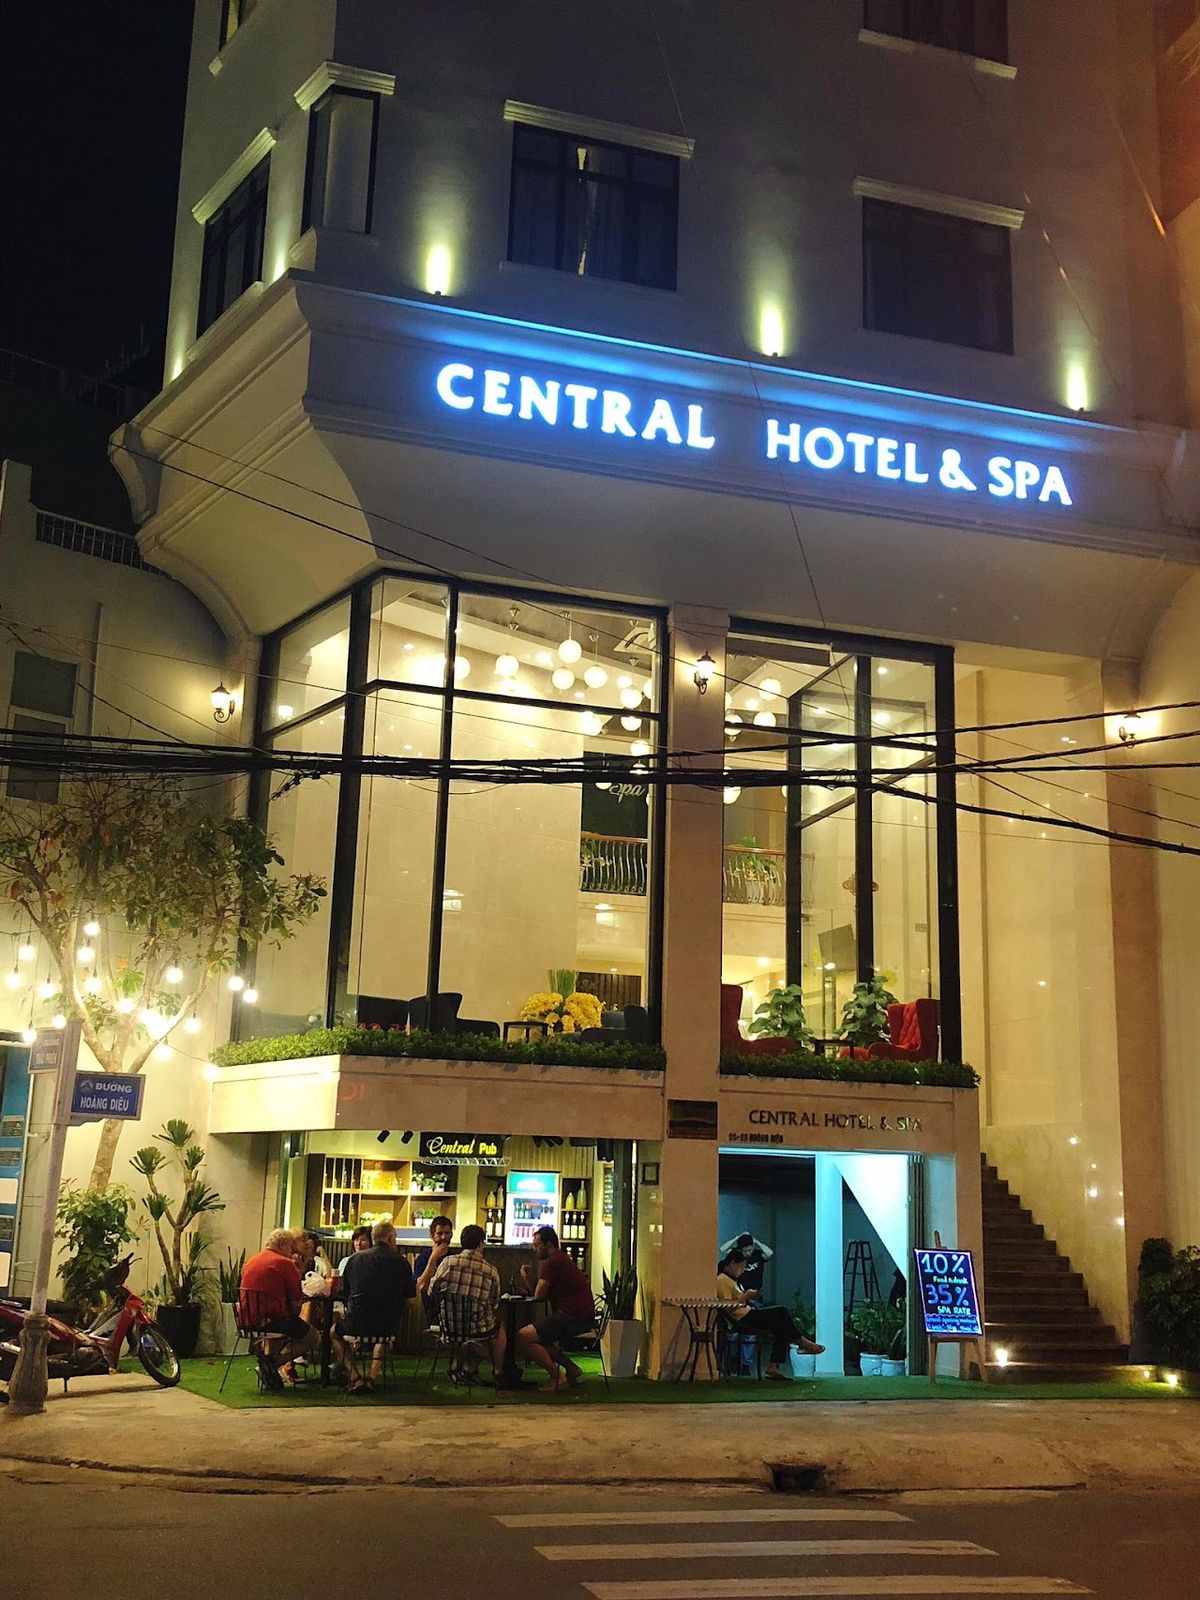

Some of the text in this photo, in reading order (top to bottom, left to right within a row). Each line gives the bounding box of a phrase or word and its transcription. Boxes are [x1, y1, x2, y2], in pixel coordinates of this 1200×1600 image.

[436, 363, 1073, 507] CENTRAL HOTEL & SPA
[95, 1081, 132, 1094] ĐƯỜNG
[80, 1095, 108, 1110] HOÀNG
[749, 1110, 923, 1132] CENTRAL HOTEL & SPA
[426, 1136, 498, 1155] Central Pub
[937, 1305, 971, 1316] SPA RATE
